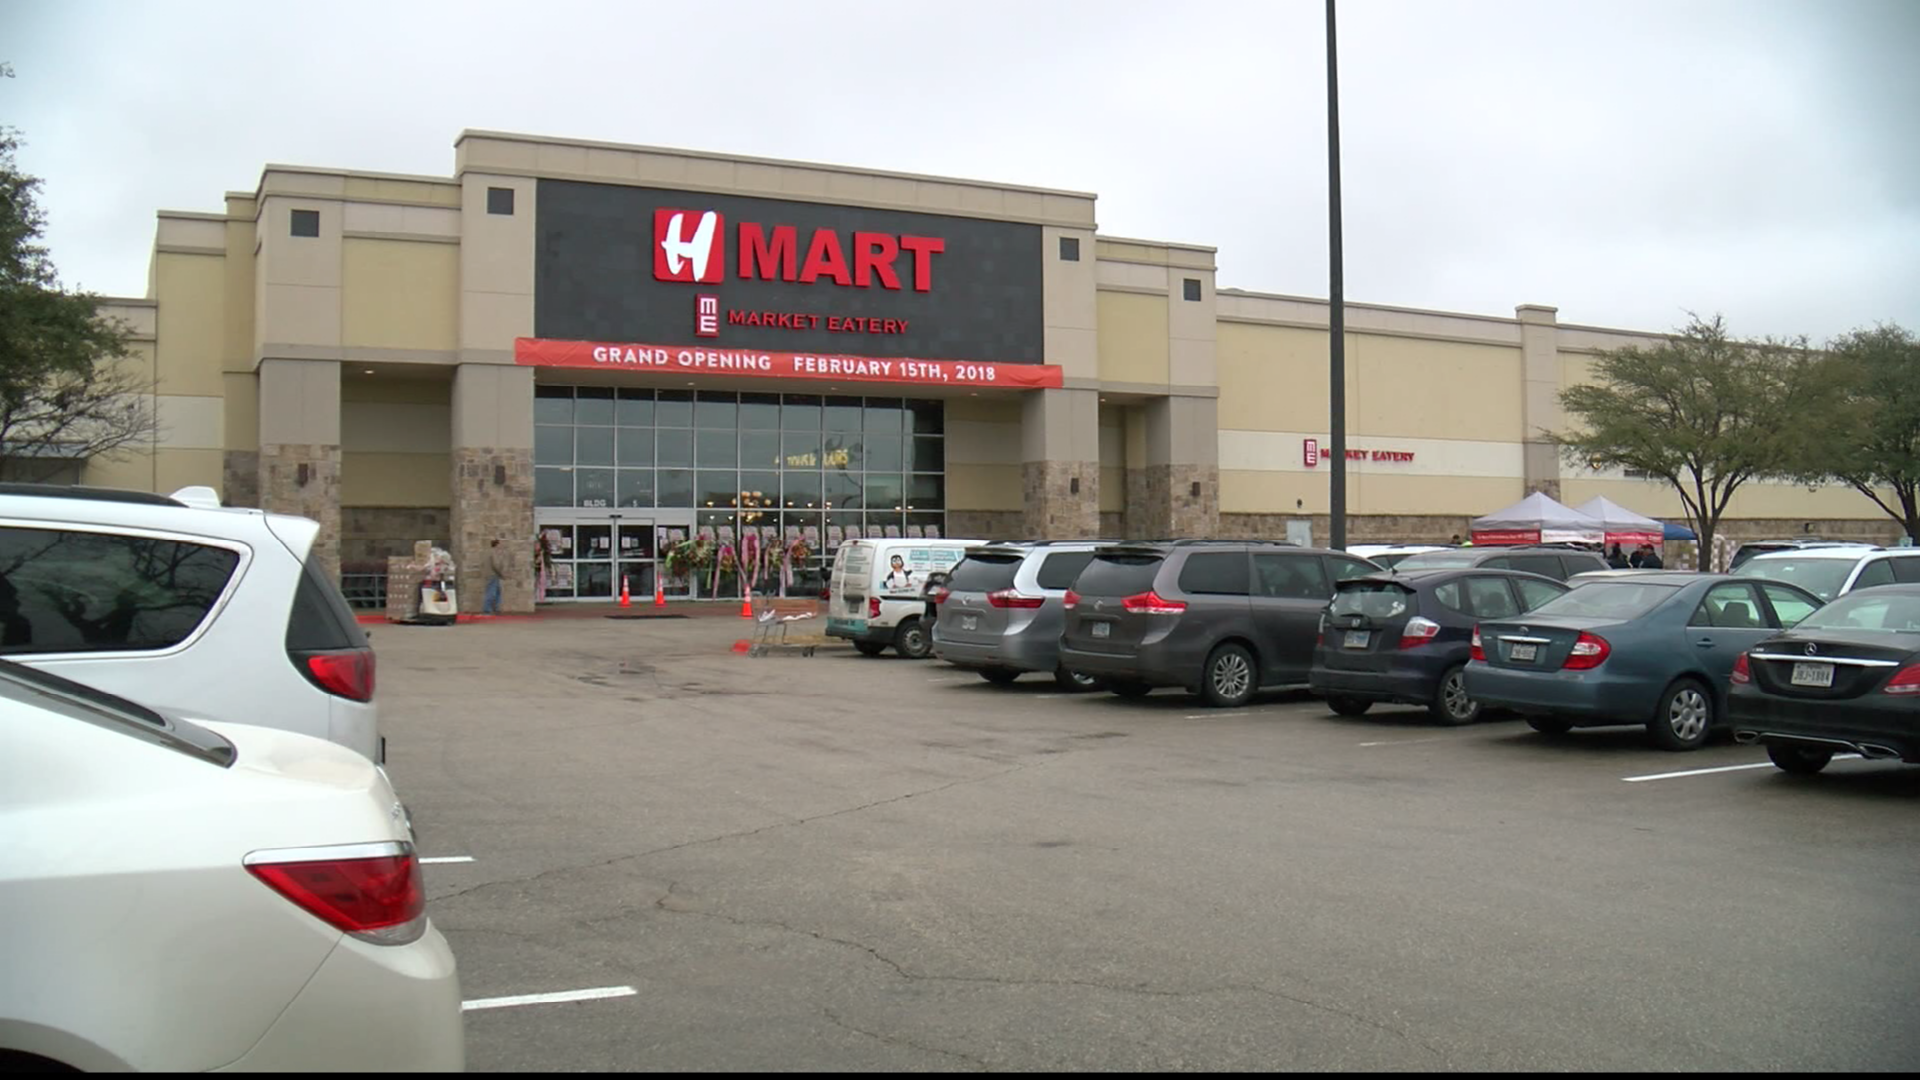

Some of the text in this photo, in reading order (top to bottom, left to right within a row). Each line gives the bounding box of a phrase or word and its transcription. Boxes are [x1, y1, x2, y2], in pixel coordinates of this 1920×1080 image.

[660, 210, 945, 292] H MART
[728, 309, 909, 334] MARKET EATERY
[593, 347, 996, 382] GRAND OPENING FEBRUARY 15TH, 2018
[1320, 448, 1415, 462] MKET EATERY
[583, 499, 607, 507] BLDG
